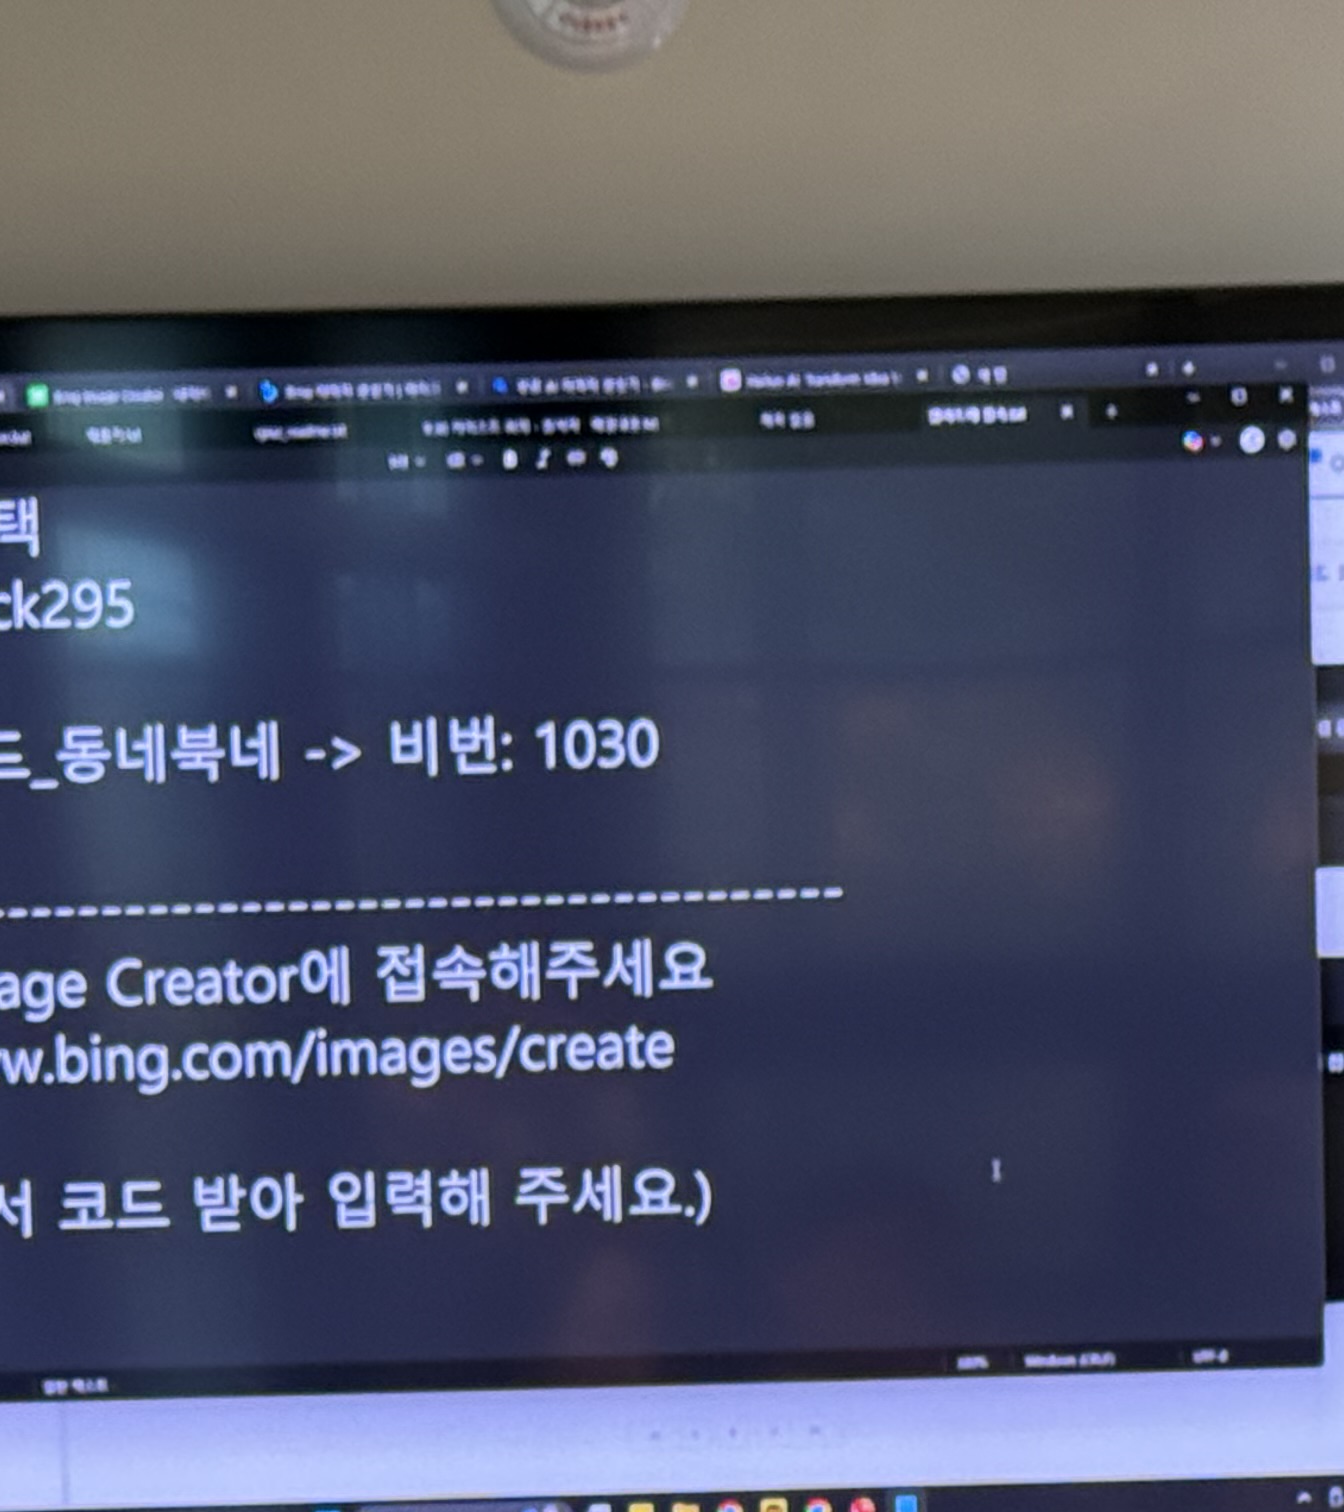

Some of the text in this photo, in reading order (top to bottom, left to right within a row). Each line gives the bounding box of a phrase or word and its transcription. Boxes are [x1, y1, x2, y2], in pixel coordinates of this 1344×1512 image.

[390, 714, 513, 777] 비번:
[535, 718, 660, 770] 1030
[105, 945, 352, 1008] Creator에
[376, 938, 713, 1003] 접속해주세요
[57, 1180, 172, 1231] 코드
[193, 1172, 304, 1233] 받아
[327, 1166, 490, 1229] 입력해
[515, 1163, 713, 1225] 주세요.)
